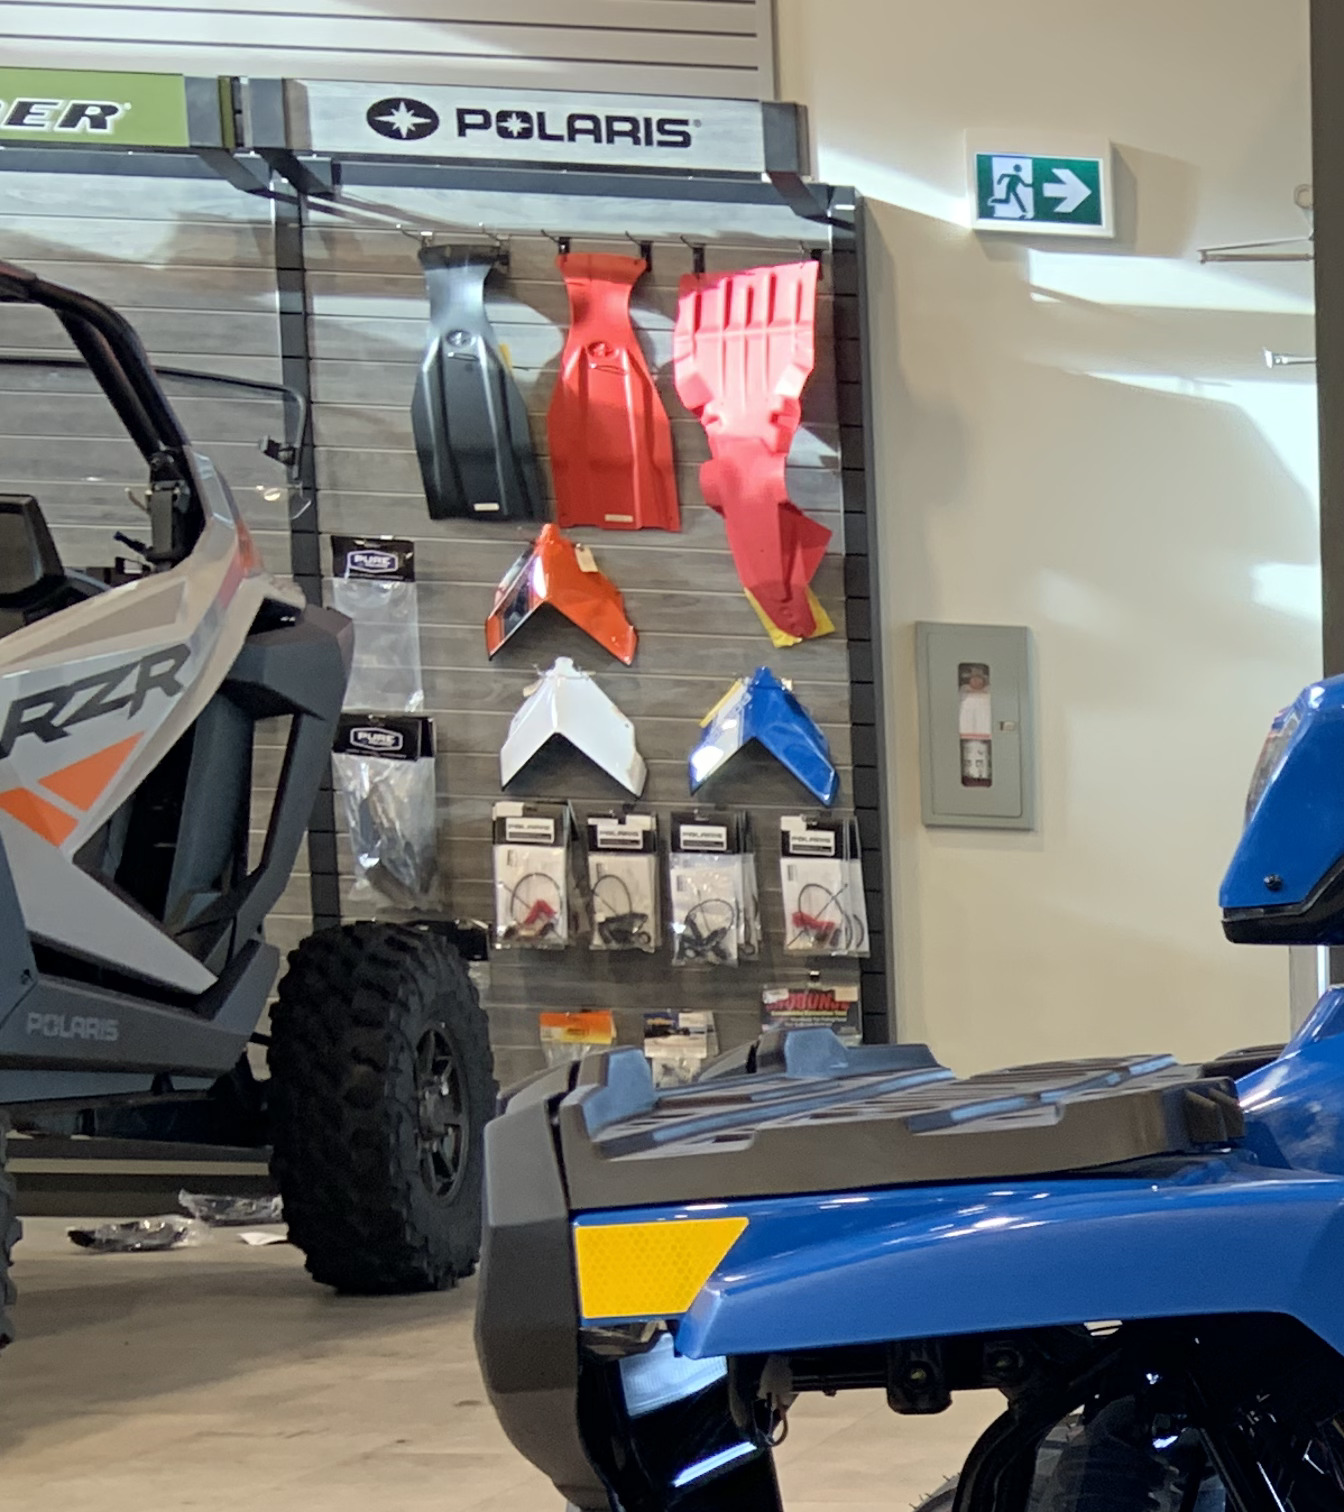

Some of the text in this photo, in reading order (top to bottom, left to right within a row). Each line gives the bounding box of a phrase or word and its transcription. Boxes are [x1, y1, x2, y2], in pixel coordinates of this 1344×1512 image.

[0, 97, 123, 134] ER
[456, 107, 692, 149] POLARIS
[0, 643, 191, 760] RZR
[27, 1012, 119, 1042] POLARIS
